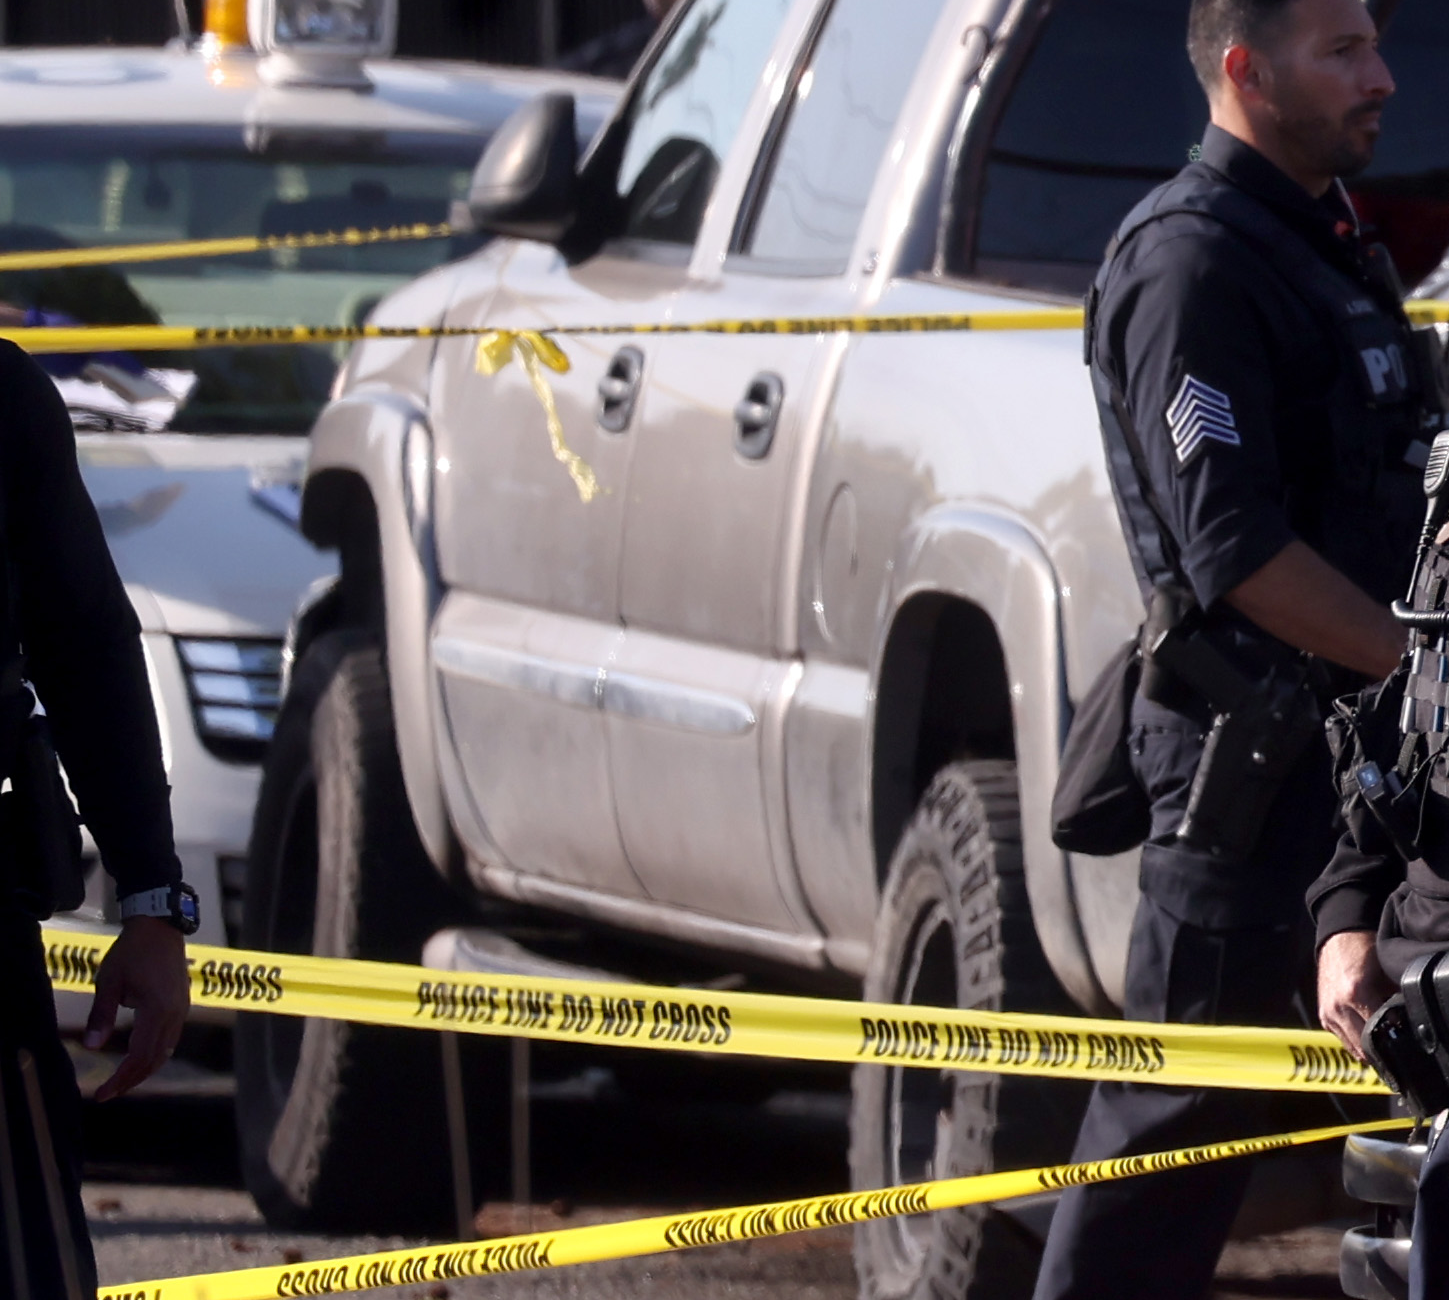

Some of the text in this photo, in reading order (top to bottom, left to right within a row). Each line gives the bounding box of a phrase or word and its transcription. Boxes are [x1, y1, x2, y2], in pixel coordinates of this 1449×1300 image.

[201, 960, 283, 1002] CROSS
[414, 981, 732, 1044] POLICE LINE DO NOT CROSS
[858, 1018, 1165, 1073] POLICE LINE DO NOT CROSS
